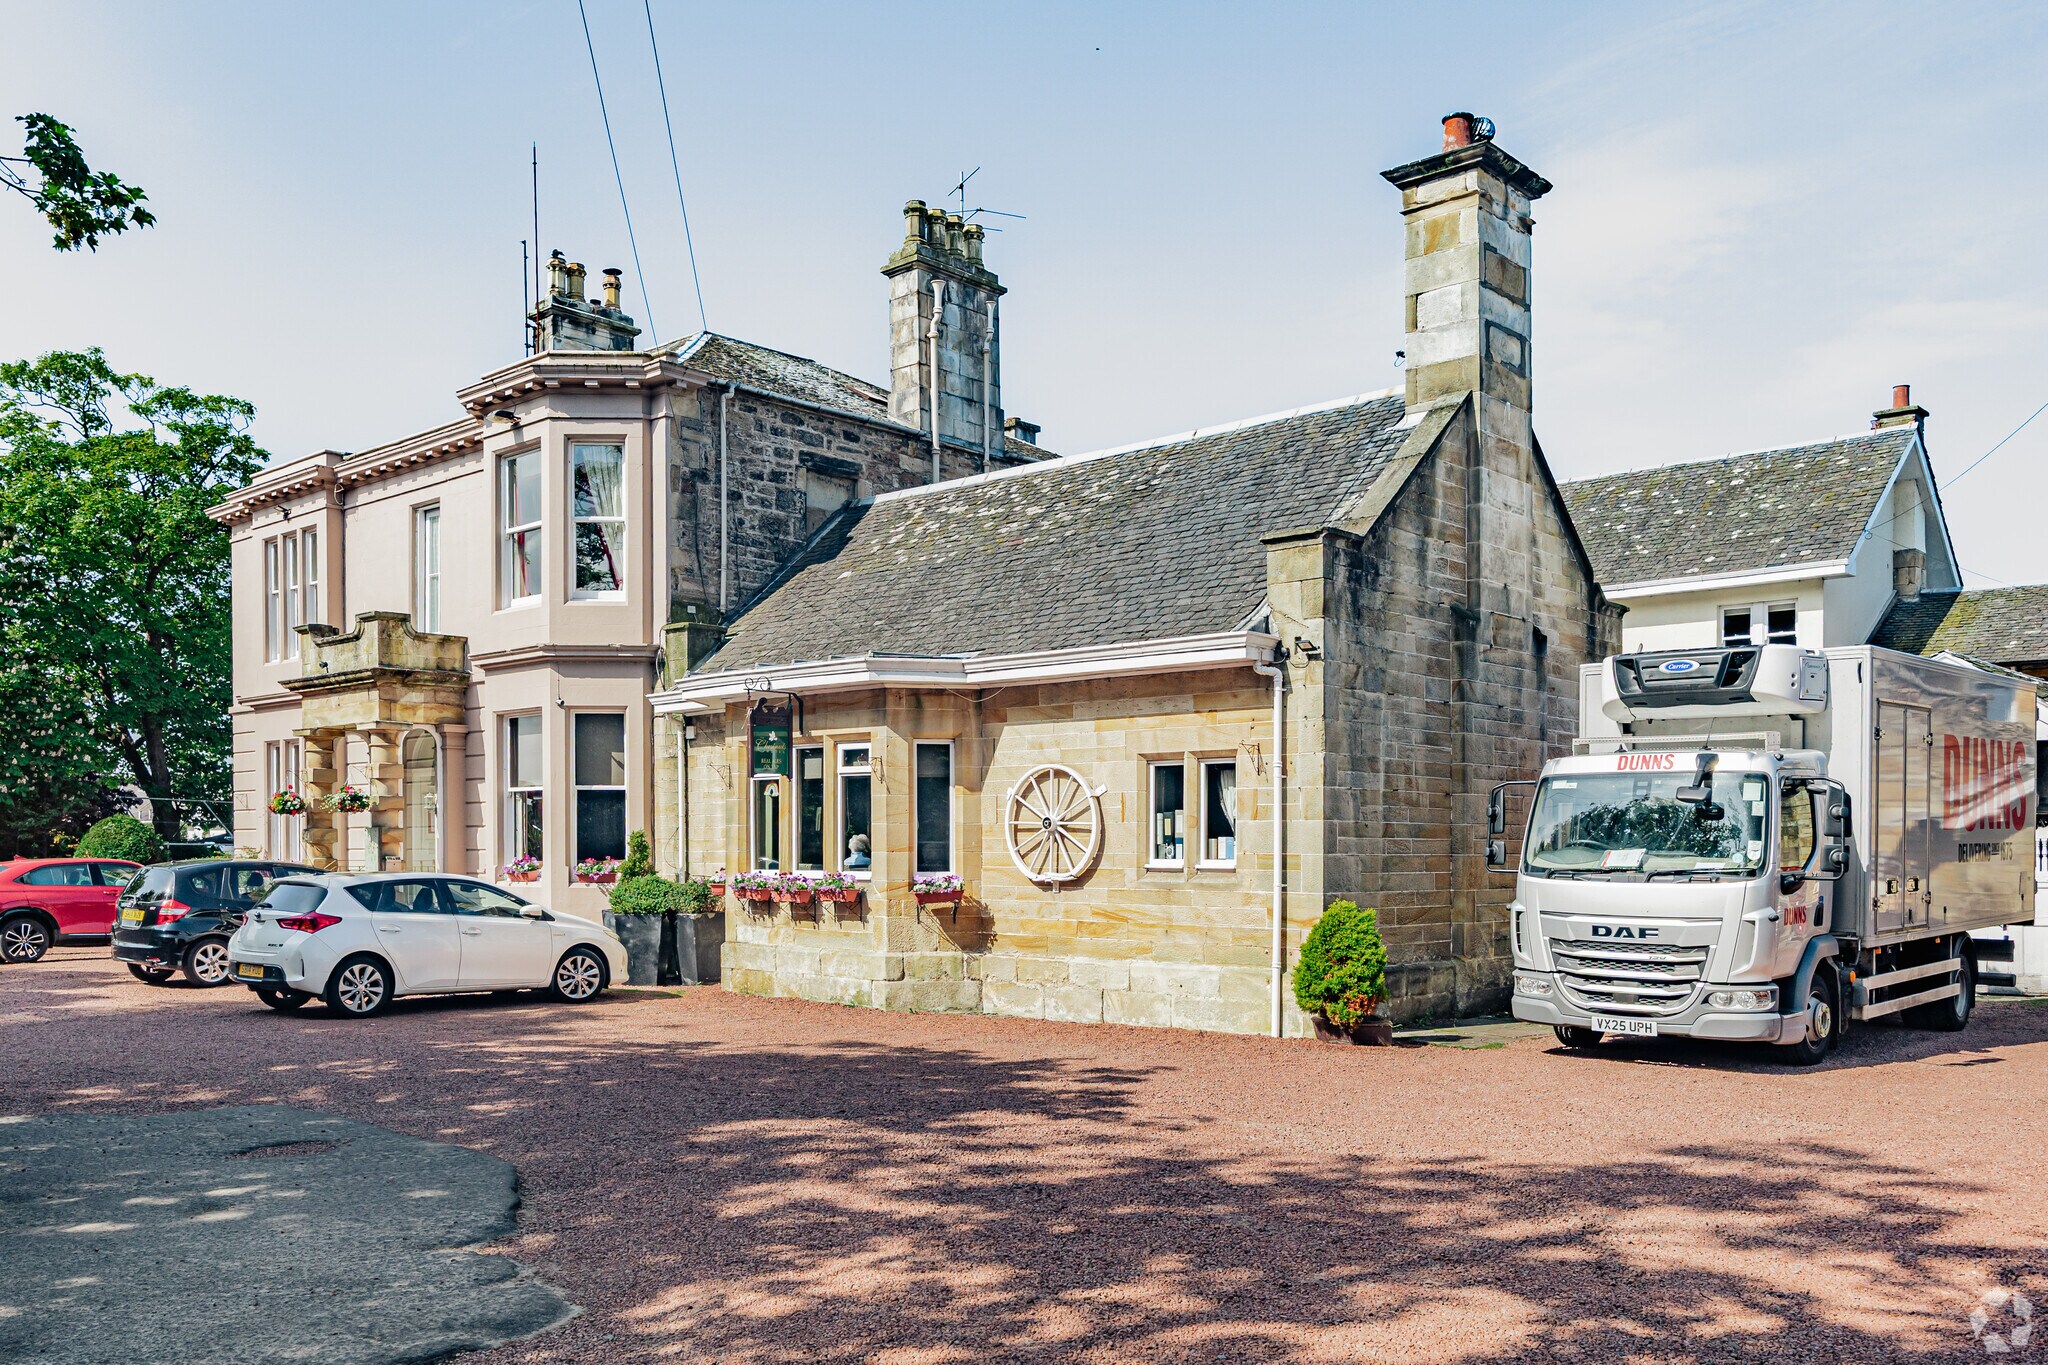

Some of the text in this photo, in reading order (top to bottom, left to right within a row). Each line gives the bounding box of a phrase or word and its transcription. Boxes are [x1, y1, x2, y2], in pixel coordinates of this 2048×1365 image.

[1617, 754, 1675, 770] DUNNS
[1943, 734, 2027, 832] DUNNS
[1958, 842, 1991, 863] DELIVERING
[1784, 906, 1807, 926] DUNNS
[1592, 925, 1659, 939] DAF
[1597, 1018, 1653, 1033] VX25 UPH
